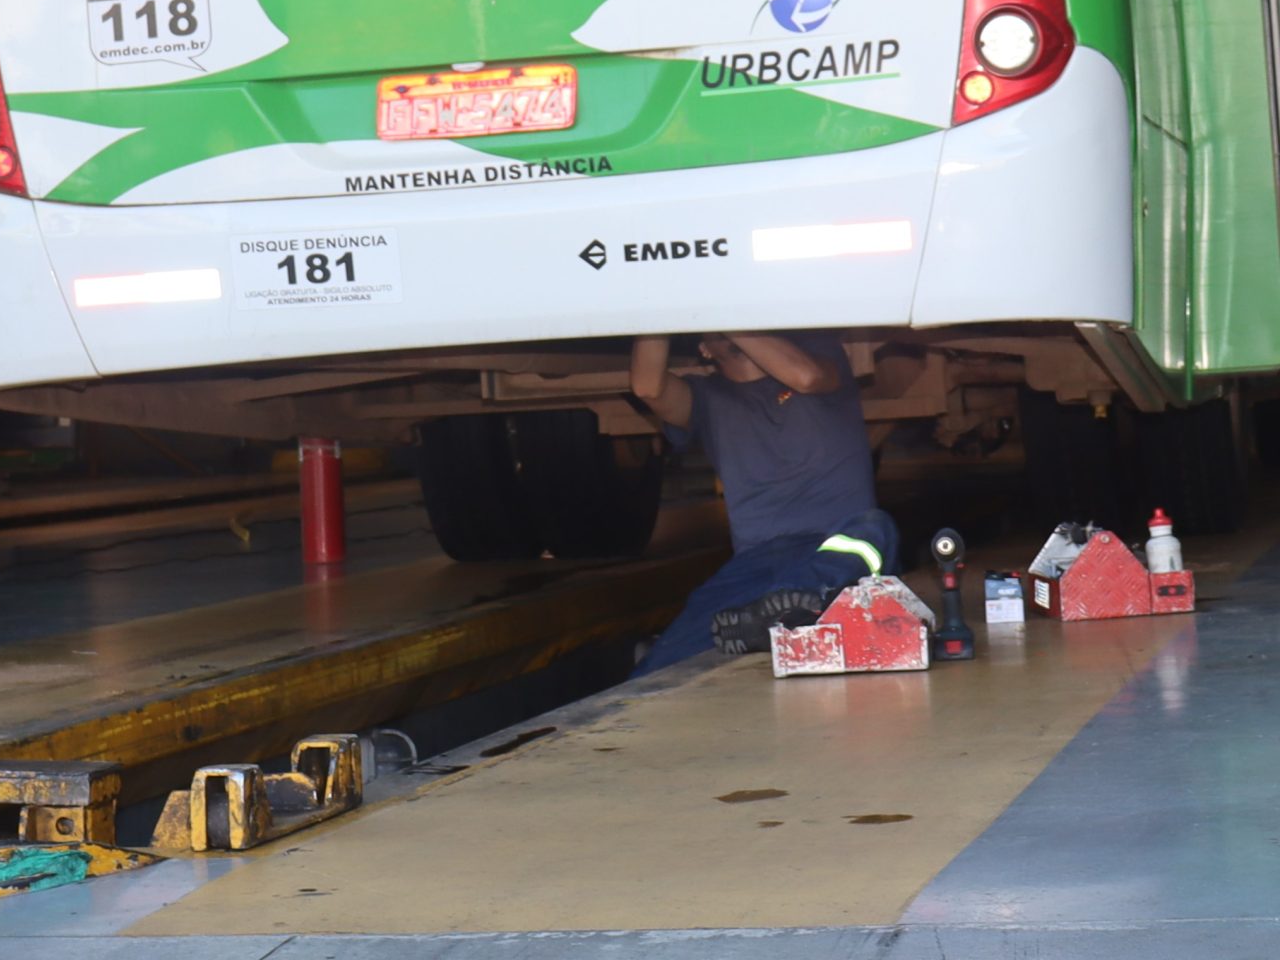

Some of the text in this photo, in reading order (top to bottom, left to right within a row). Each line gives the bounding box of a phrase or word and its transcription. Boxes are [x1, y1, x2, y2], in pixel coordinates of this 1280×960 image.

[99, 40, 206, 58] emdec.com.br
[701, 39, 900, 90] URBCAMP
[345, 155, 613, 192] MANTENHA DISTÂNCIA
[240, 234, 387, 253] DISQUE DENÚNCIA
[624, 238, 728, 262] EMDEC
[277, 251, 355, 285] 181
[267, 294, 327, 305] ATENDIMENTO
